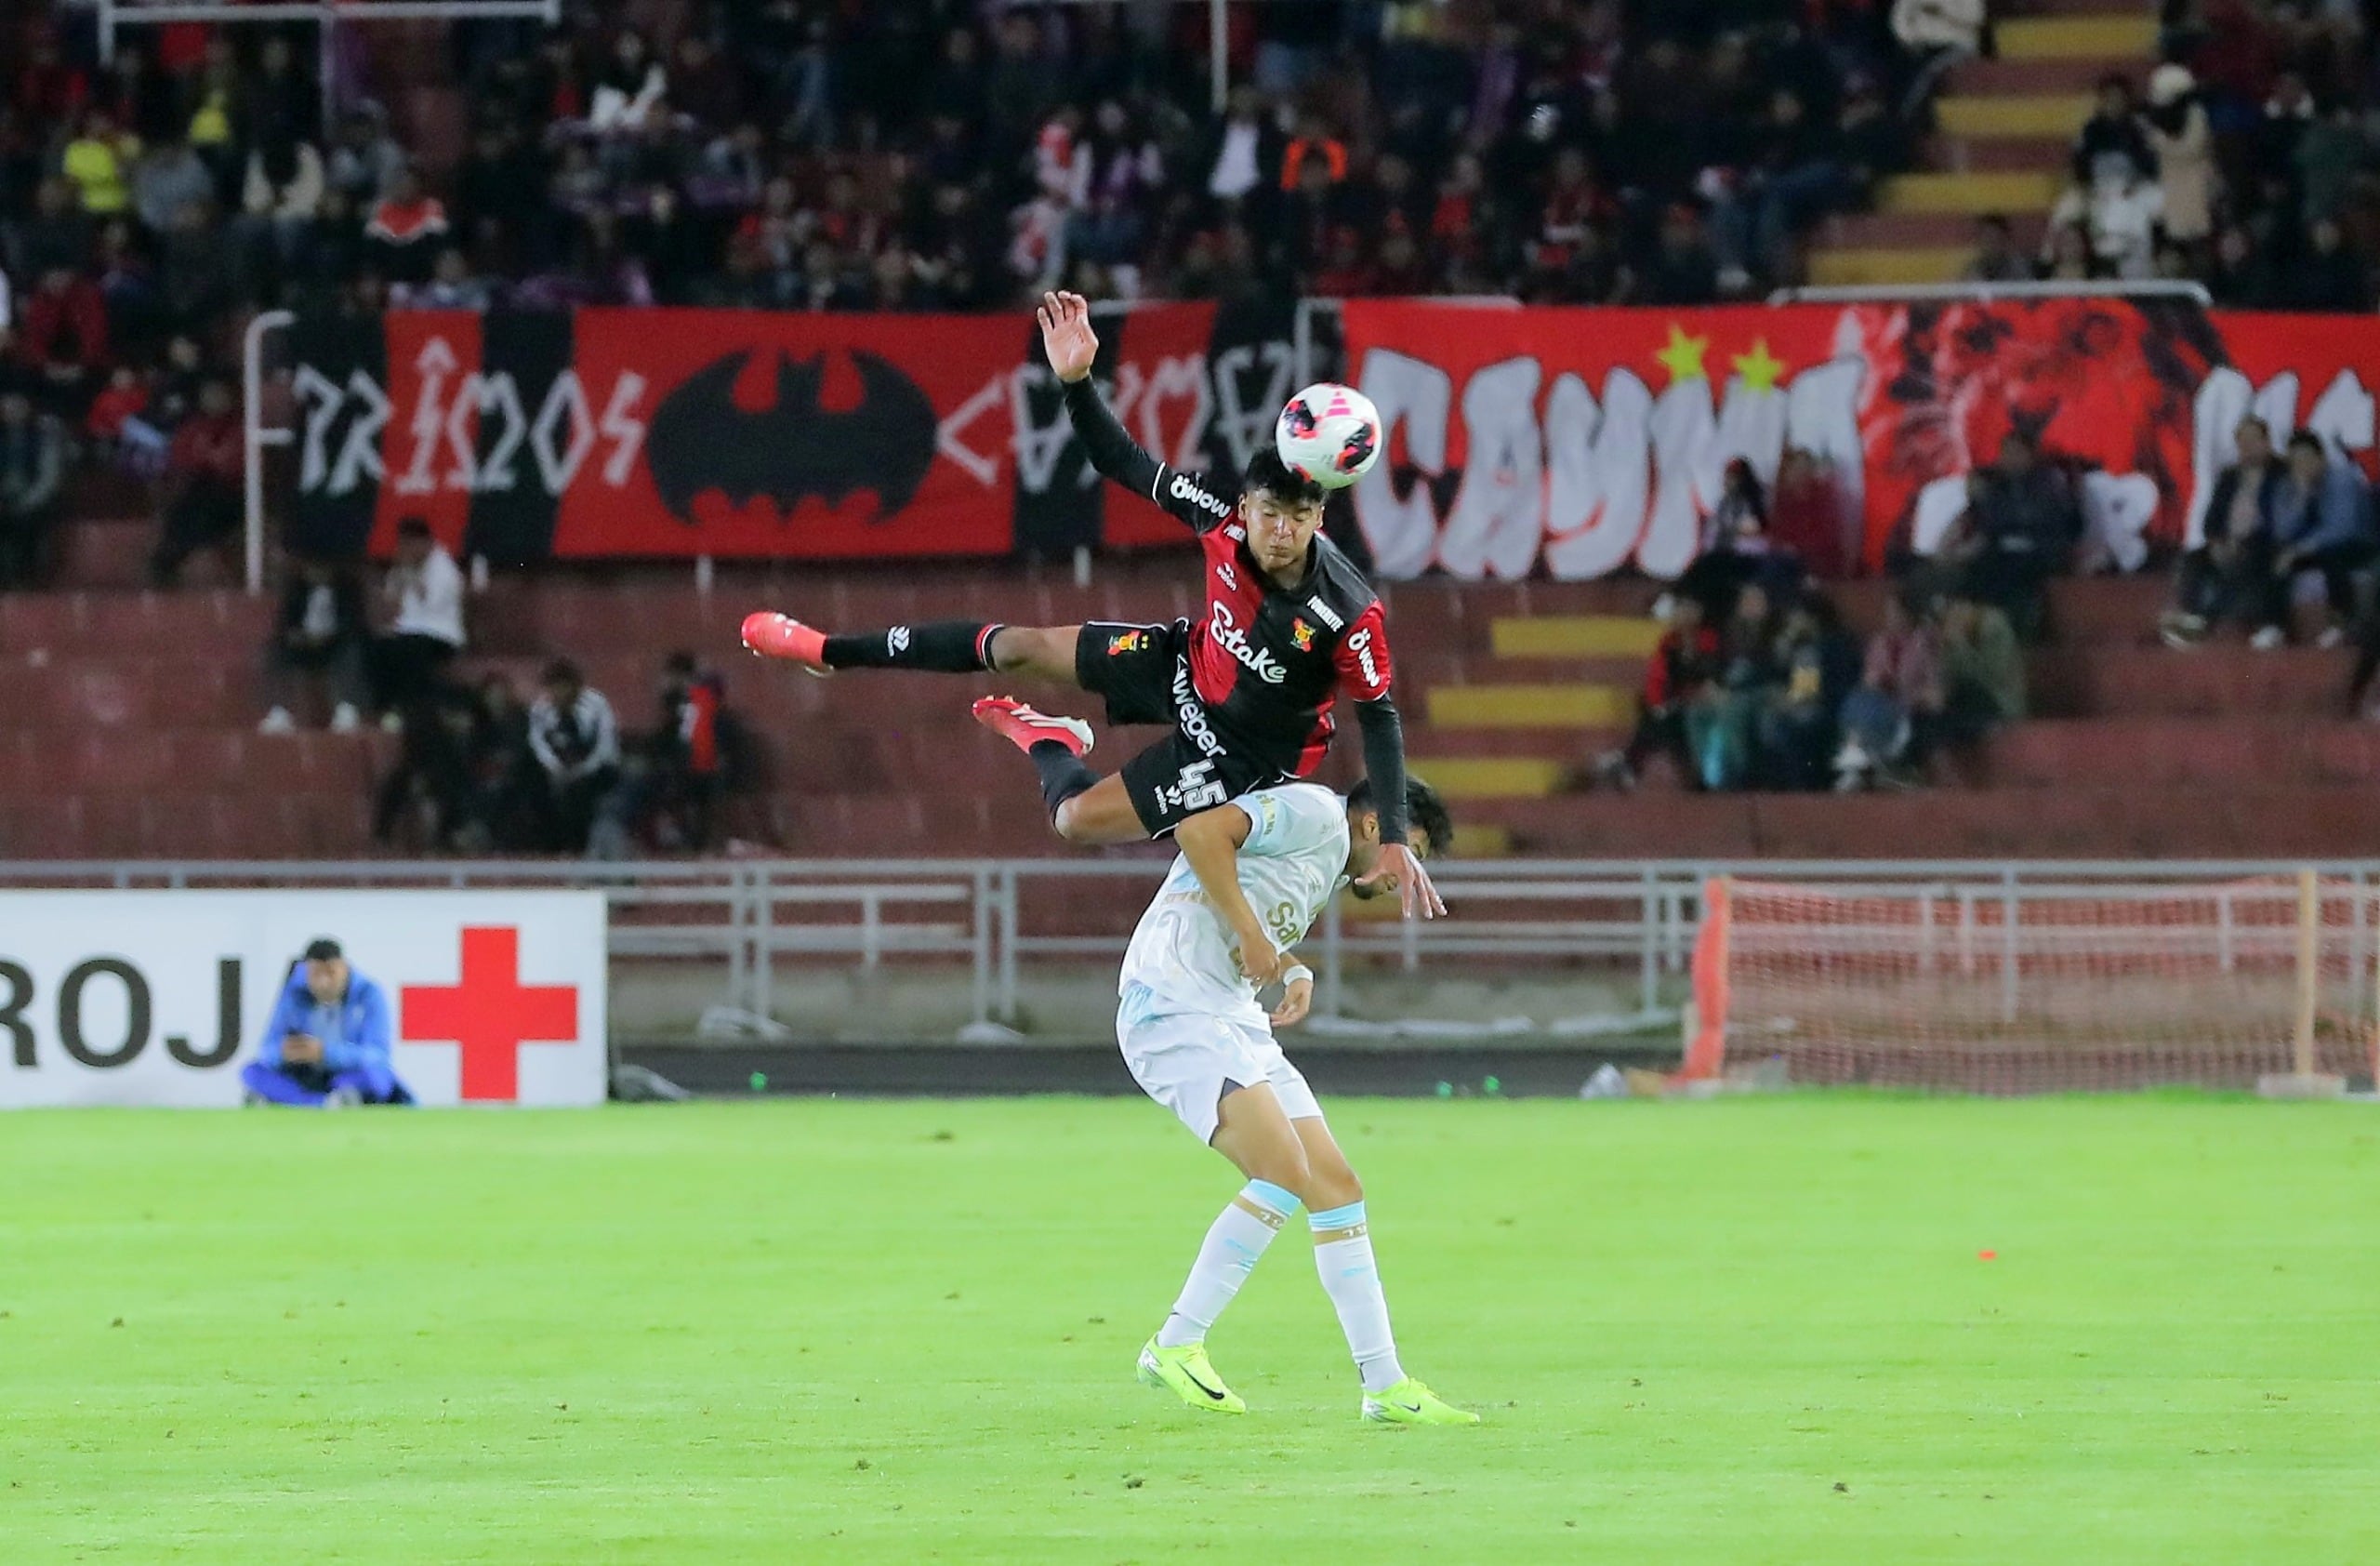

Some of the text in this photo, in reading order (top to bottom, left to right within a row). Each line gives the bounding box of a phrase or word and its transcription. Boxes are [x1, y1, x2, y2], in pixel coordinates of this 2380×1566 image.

[1210, 600, 1287, 683] Stake
[1172, 680, 1227, 757] weber
[1154, 785, 1169, 816] walon
[1178, 757, 1227, 812] 45
